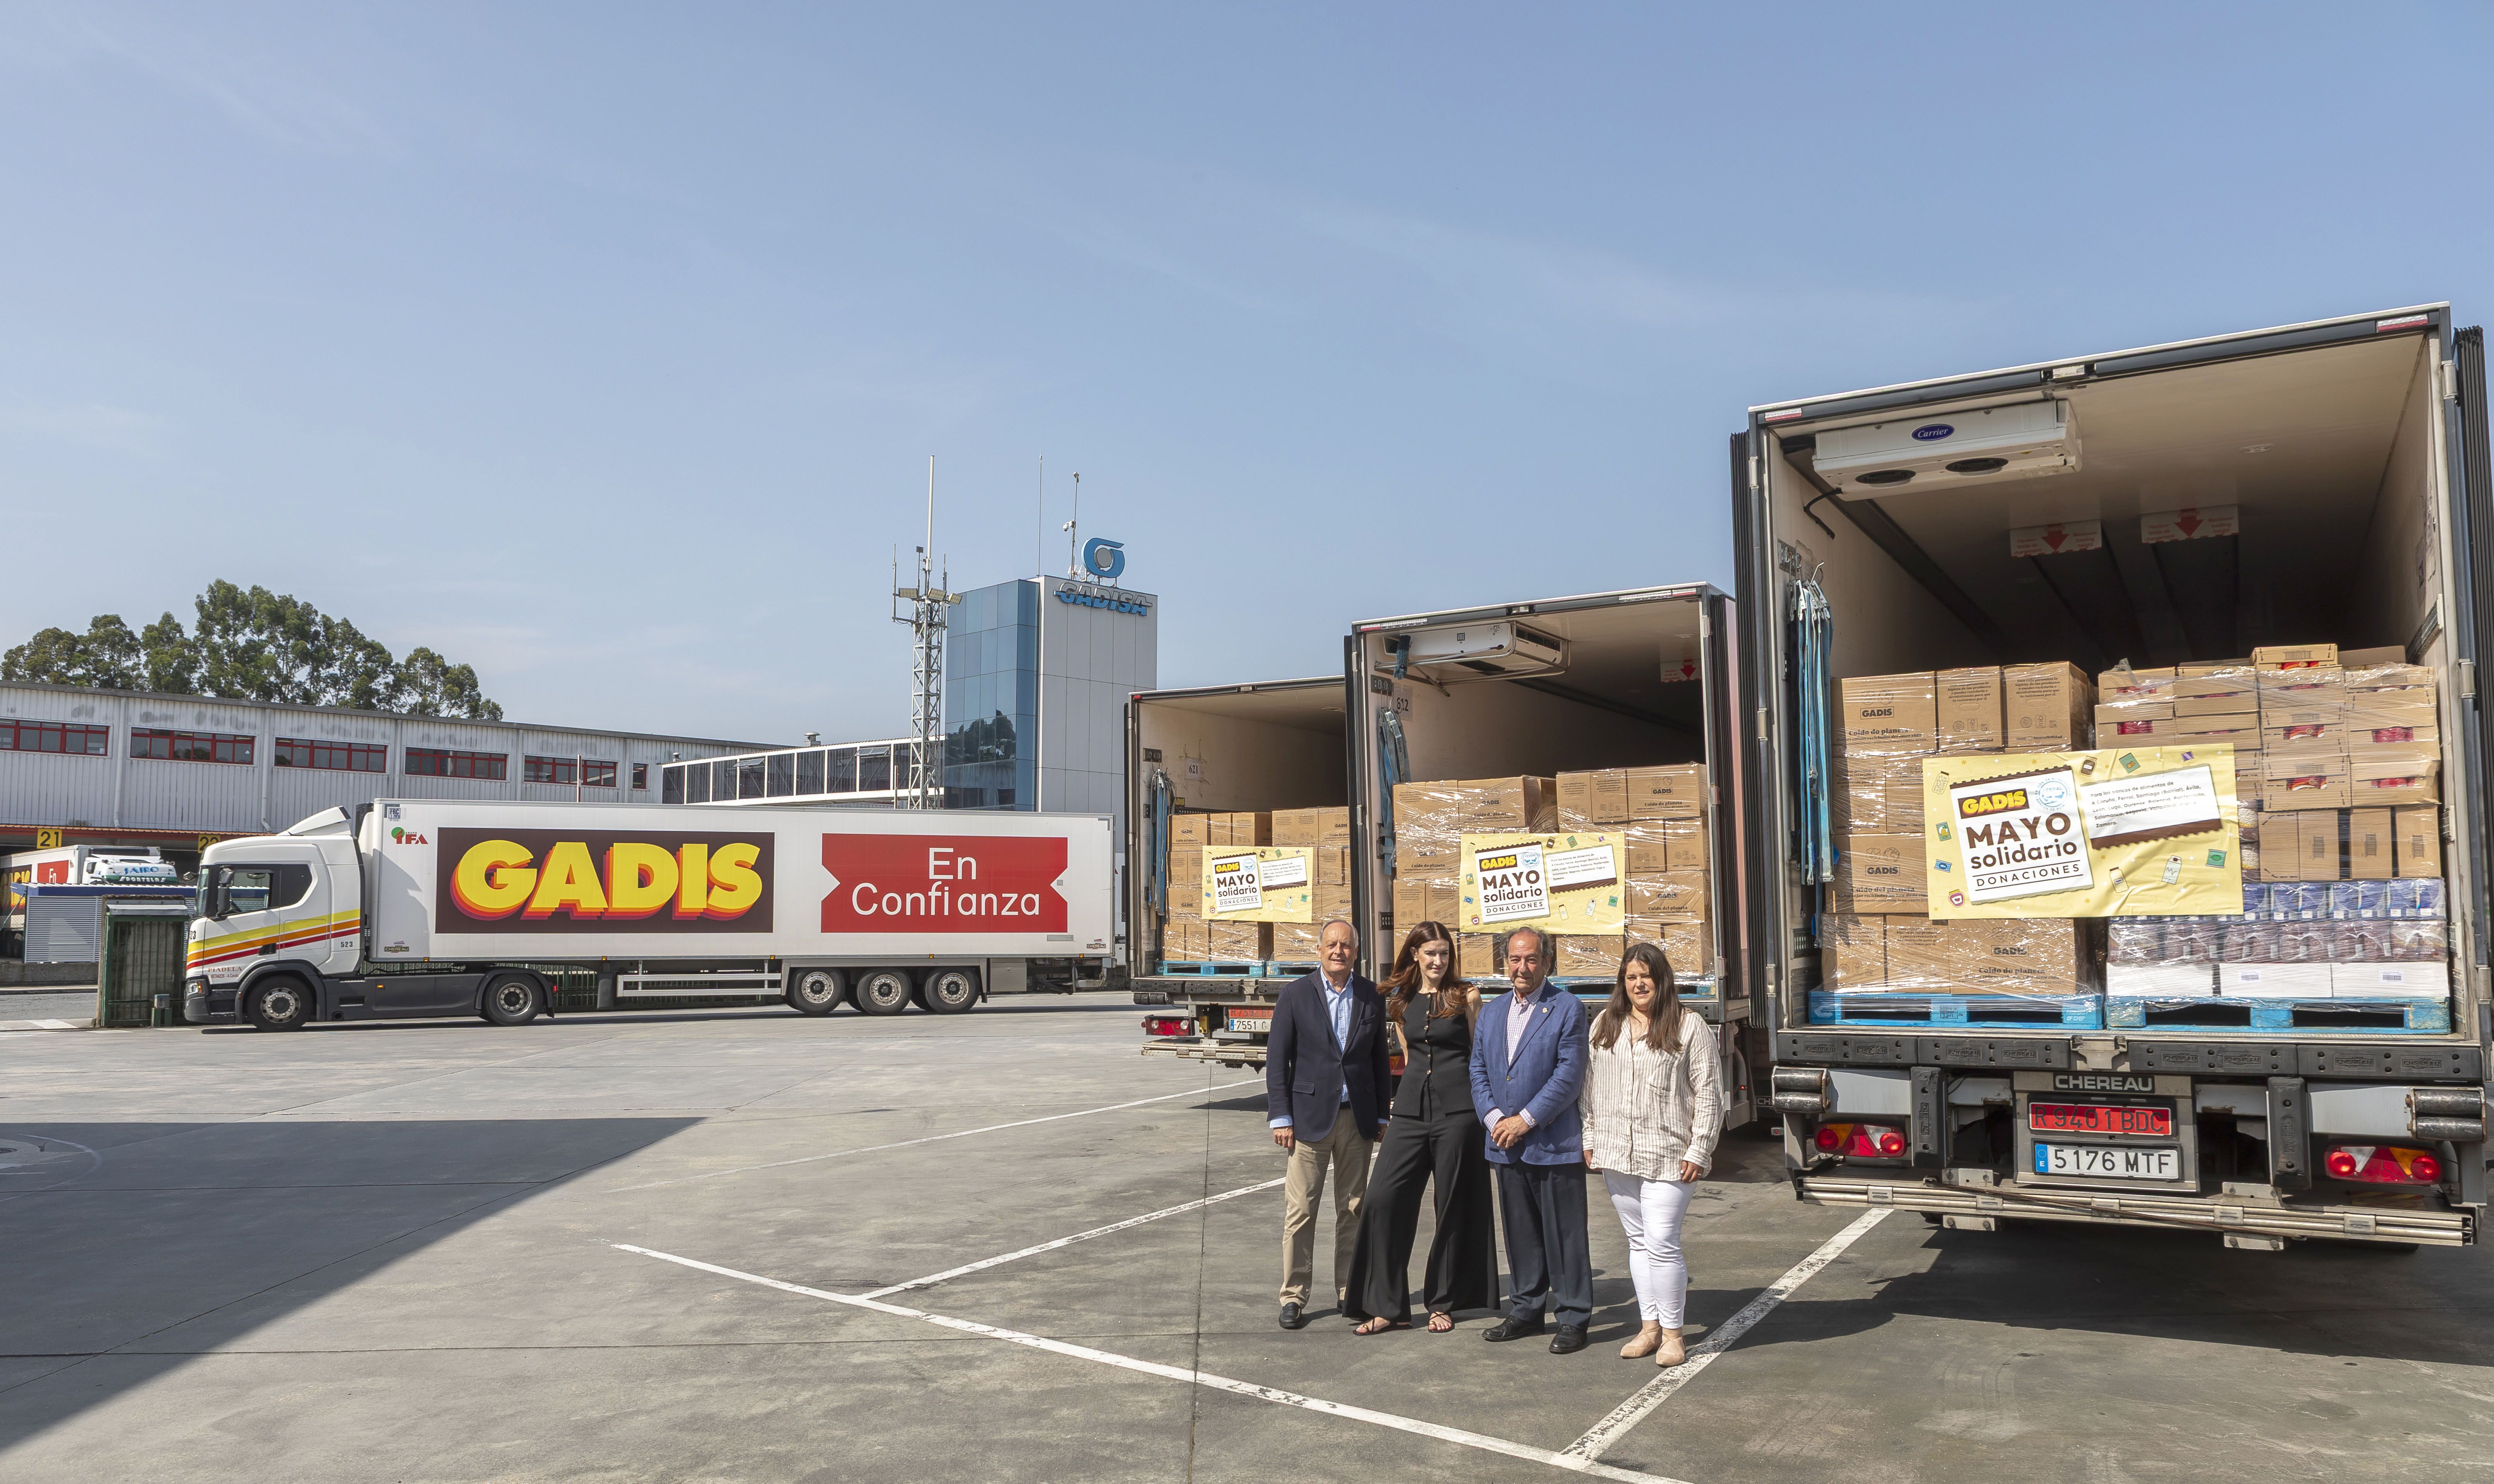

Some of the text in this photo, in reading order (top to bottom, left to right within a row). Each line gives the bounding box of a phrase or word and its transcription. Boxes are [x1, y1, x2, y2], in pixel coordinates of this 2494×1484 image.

[1918, 429, 1948, 437] Carrier
[1053, 582, 1153, 617] GADISA
[1397, 697, 1408, 711] 612
[1862, 709, 1892, 717] GADIS
[1189, 764, 1198, 774] 621
[1962, 791, 2026, 815] GADIS
[1966, 812, 2071, 849] MAYO
[40, 831, 59, 847] 21
[1971, 839, 2077, 869] solidario
[929, 847, 977, 880] En
[1216, 863, 1239, 873] GADIS
[1481, 856, 1516, 869] GADIS
[450, 840, 763, 921] GADIS
[1217, 874, 1255, 888] MAYO
[1482, 870, 1539, 890] MAYO
[1977, 864, 2079, 886] DONACIONES
[852, 881, 1040, 916] Confianza
[1218, 886, 1257, 897] solidario
[1484, 886, 1542, 903] solidario
[1487, 902, 1542, 913] DONACIONES
[1237, 1021, 1256, 1030] 7551
[2056, 1075, 2152, 1091] CHEREAU
[2034, 1106, 2164, 1132] R 9401 BDC
[2054, 1149, 2171, 1174] 5176 MTF
